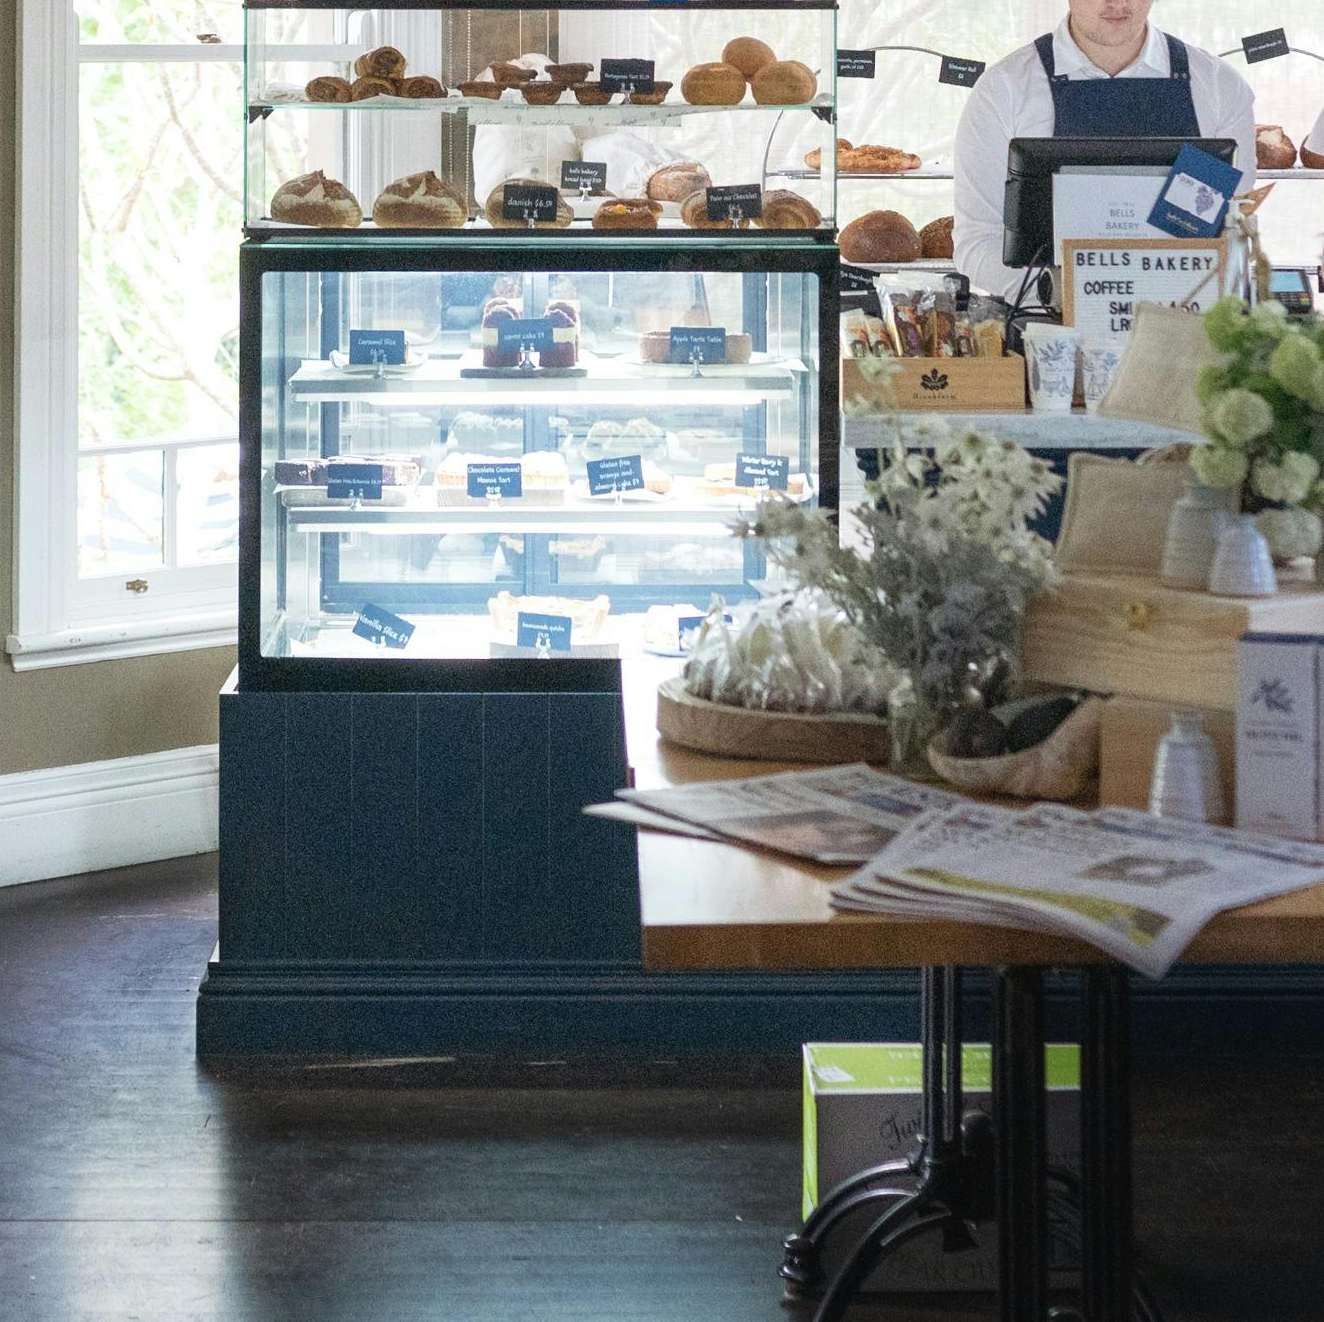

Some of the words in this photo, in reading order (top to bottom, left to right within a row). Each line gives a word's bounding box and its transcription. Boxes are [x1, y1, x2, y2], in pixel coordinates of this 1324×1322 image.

[508, 197, 533, 206] danish
[1110, 209, 1135, 217] BELLS
[1077, 252, 1131, 266] BELLS
[1142, 257, 1213, 271] BAKERY
[1084, 281, 1134, 295] COFFEE
[468, 465, 495, 473] Chocolate
[496, 465, 520, 473] Caramel
